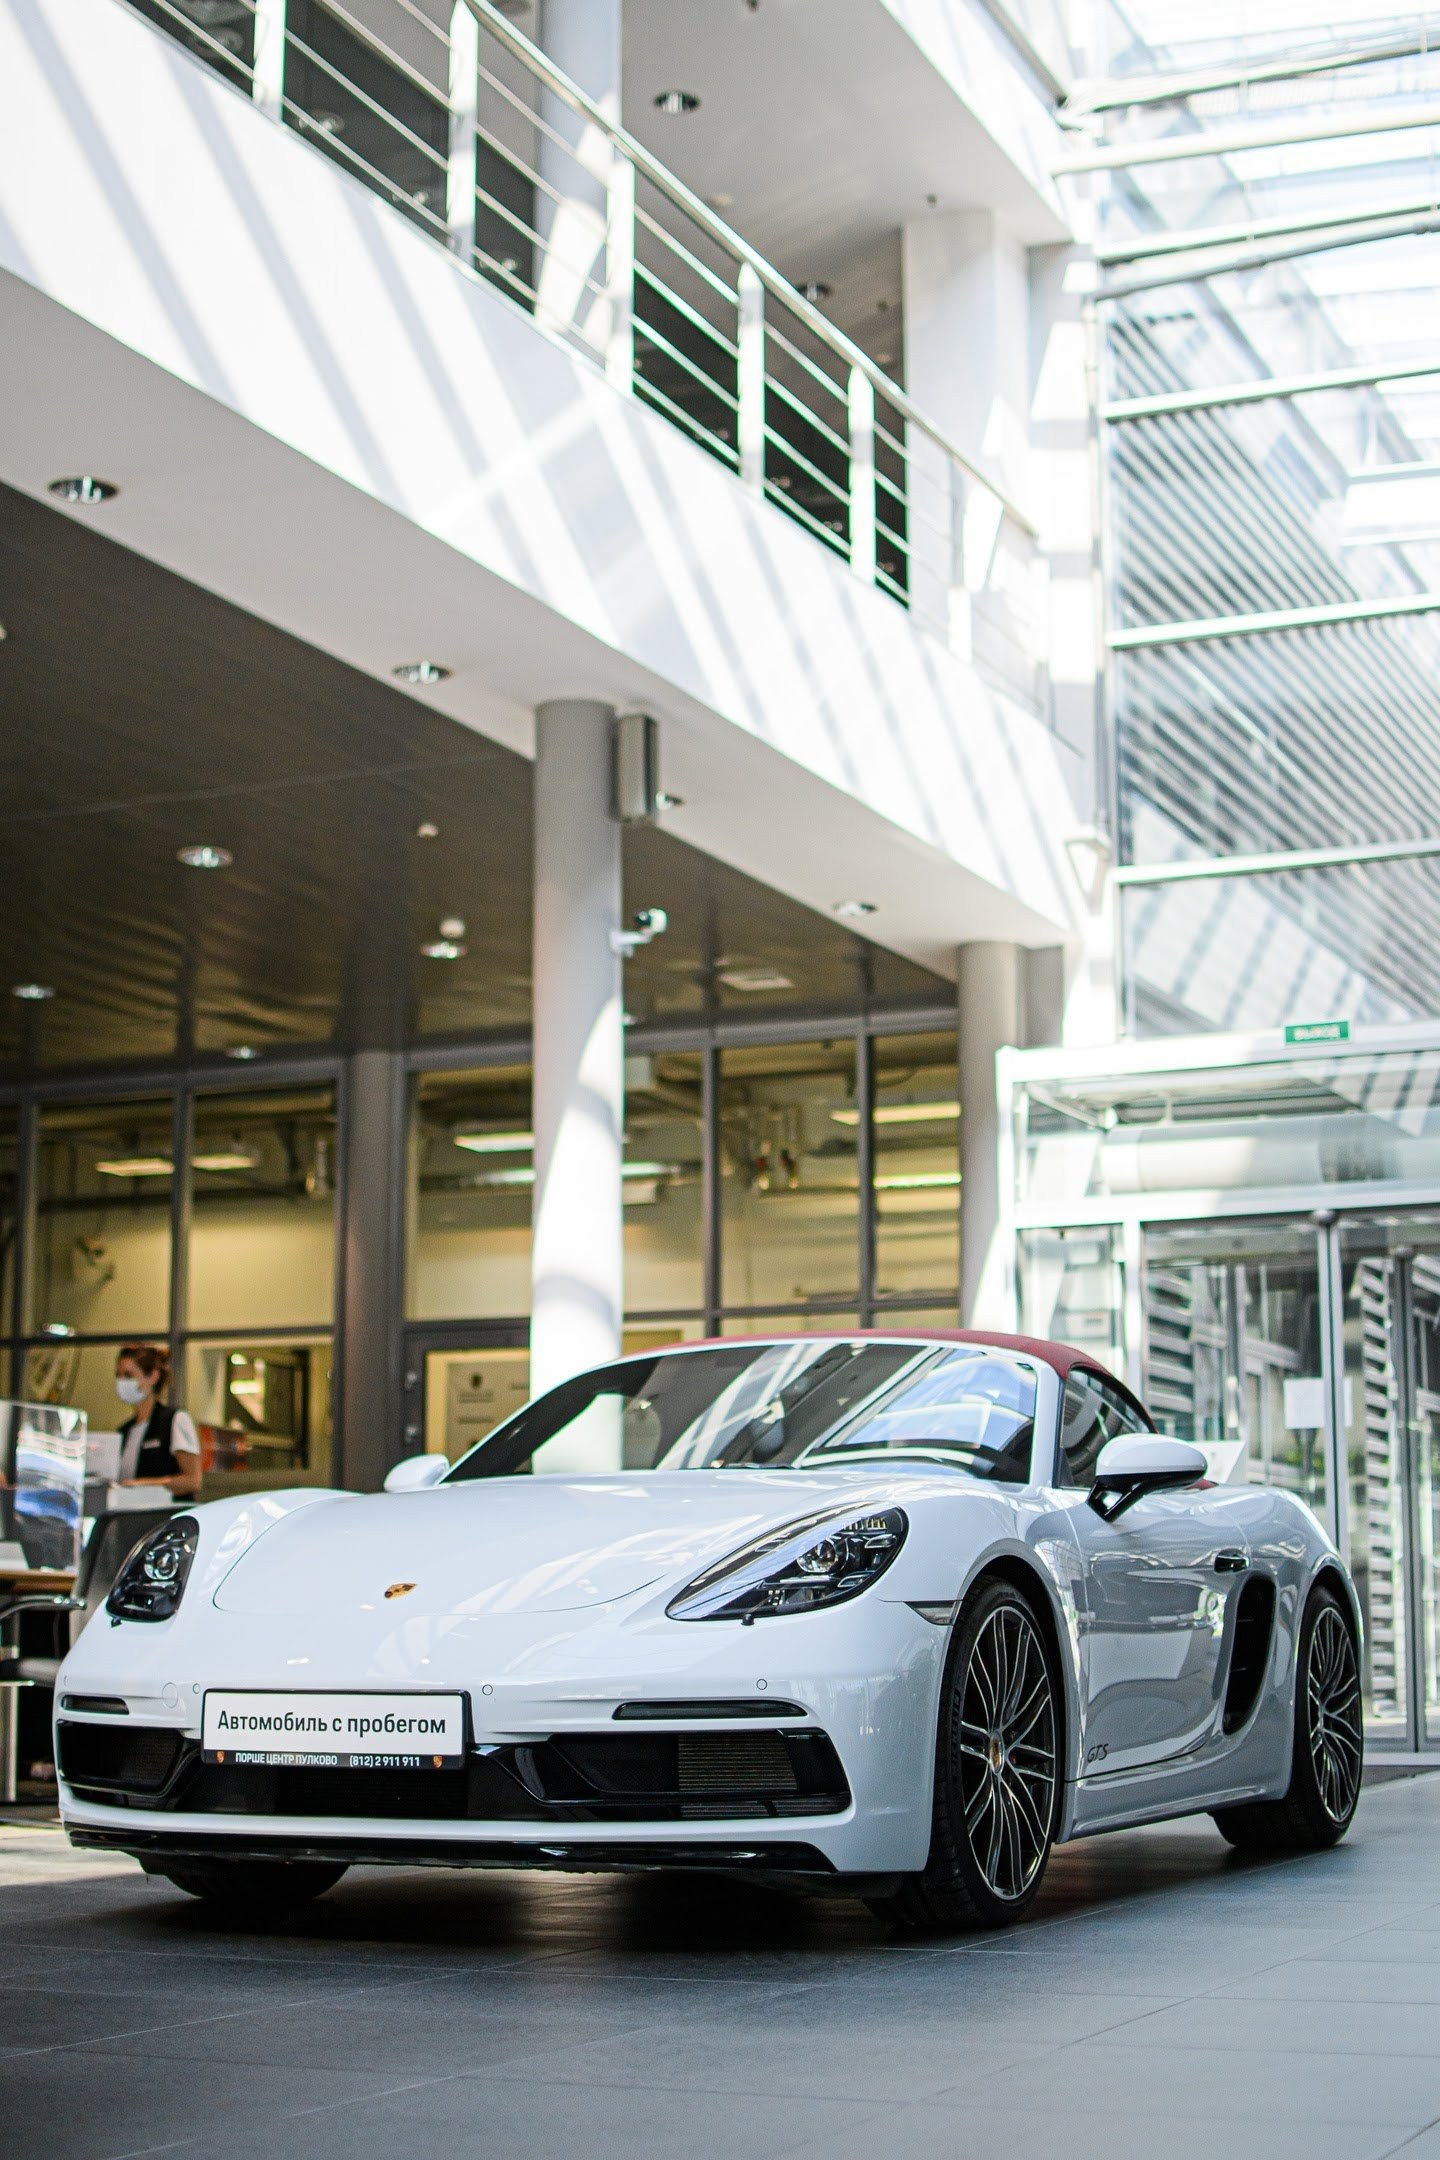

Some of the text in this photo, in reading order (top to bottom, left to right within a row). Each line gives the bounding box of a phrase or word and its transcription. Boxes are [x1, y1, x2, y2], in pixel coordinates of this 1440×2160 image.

[218, 1710, 446, 1738] Автомобиль с пробегом
[235, 1752, 266, 1764] ПОРШЕ
[266, 1753, 295, 1766] ЦЕНТР
[295, 1754, 338, 1766] ПУЛКОВО
[349, 1755, 374, 1768] (812)
[1087, 1743, 1109, 1763] GTS
